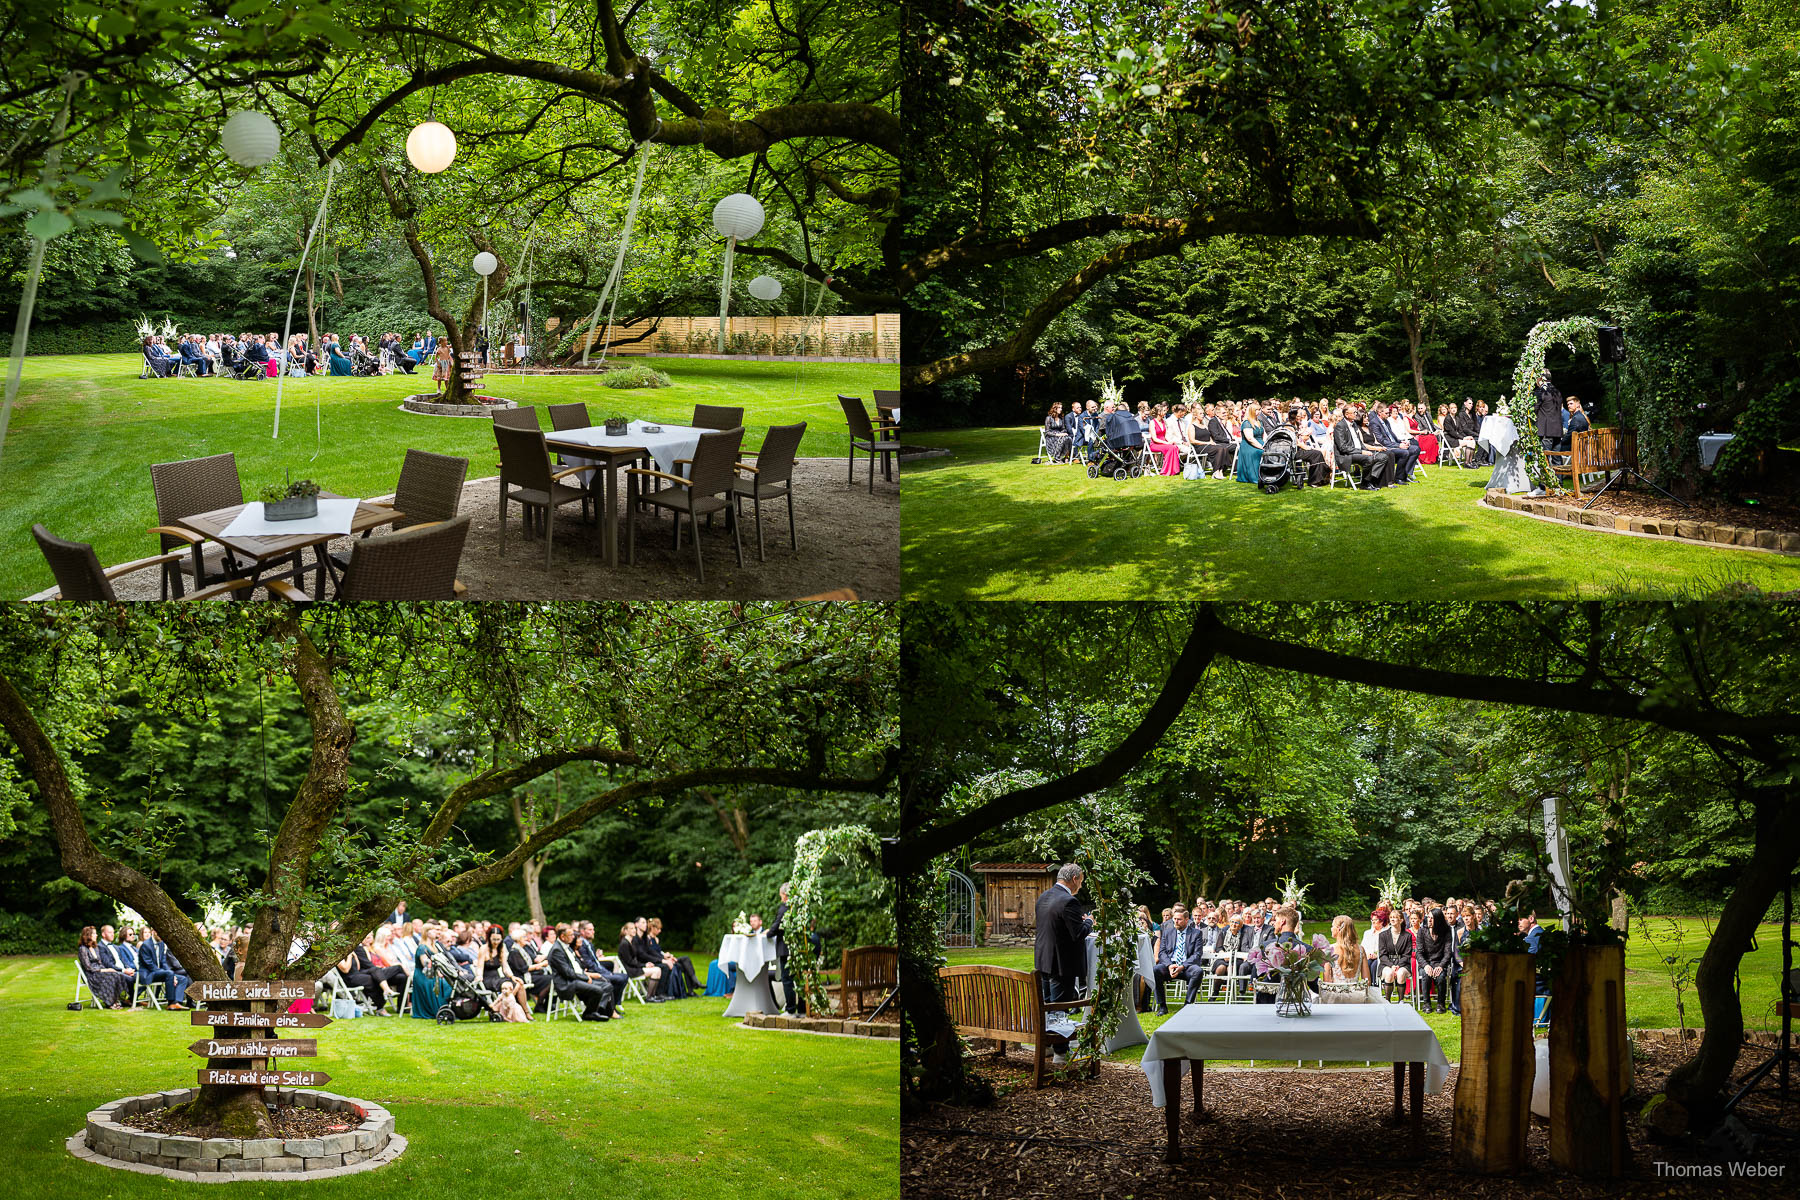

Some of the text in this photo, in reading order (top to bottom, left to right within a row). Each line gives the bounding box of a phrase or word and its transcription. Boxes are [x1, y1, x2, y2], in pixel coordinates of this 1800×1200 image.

[202, 982, 305, 999] Heute wird aus
[207, 1013, 229, 1025] zwei
[233, 1012, 270, 1026] Familien
[207, 1041, 298, 1057] Drum wähle einen
[240, 1071, 257, 1083] nicht
[260, 1072, 280, 1084] eine
[282, 1071, 315, 1086] Seite!
